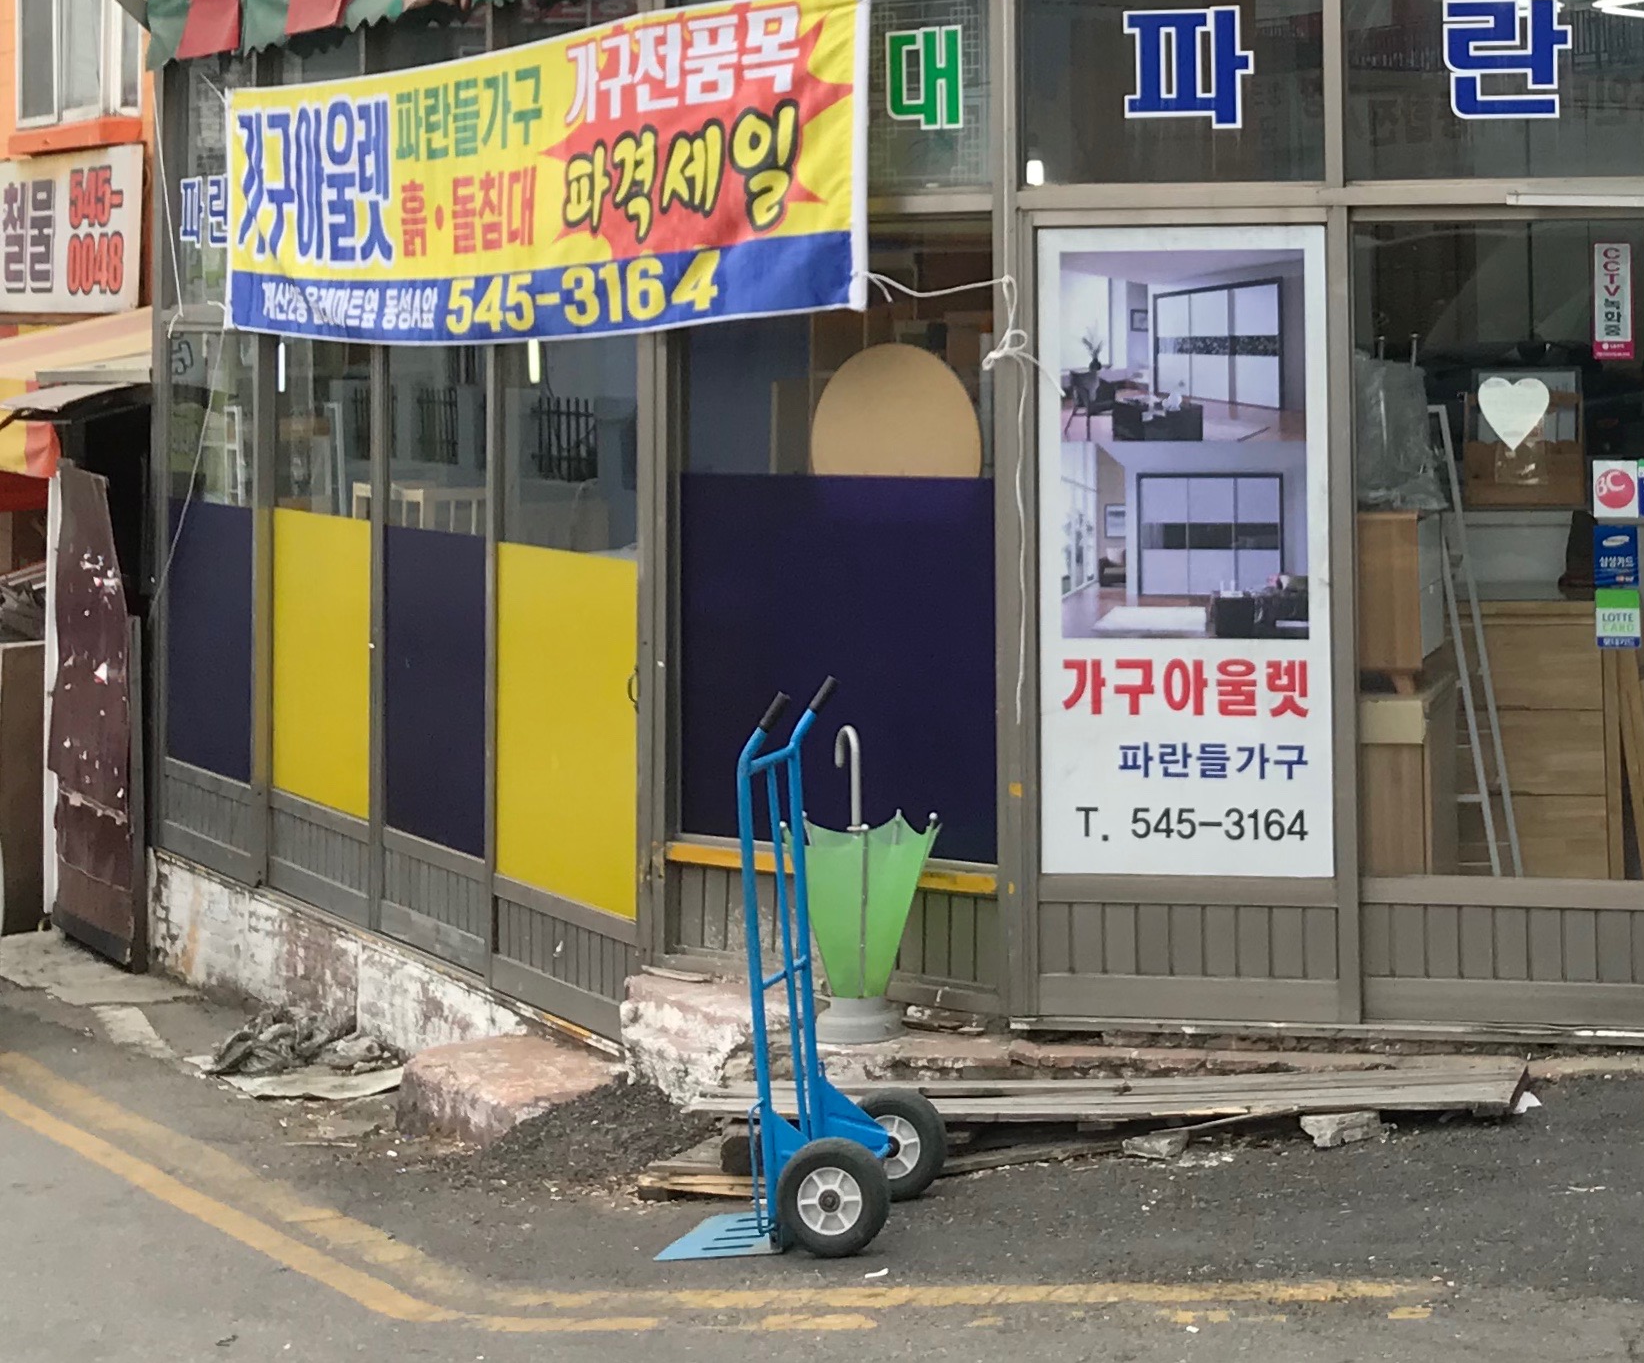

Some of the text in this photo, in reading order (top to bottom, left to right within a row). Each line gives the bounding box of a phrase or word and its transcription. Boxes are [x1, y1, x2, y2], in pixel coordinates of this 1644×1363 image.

[565, 2, 801, 125] 가구전품목
[886, 25, 964, 131] 대
[395, 65, 544, 162] 파란들가구
[236, 91, 395, 264] 가구아울렛
[563, 98, 801, 243] 파격세일
[66, 230, 125, 295] 0048
[445, 247, 720, 335] 545-3164
[1602, 613, 1635, 623] LOTTE
[1063, 659, 1309, 718] 가구아울렛
[1119, 742, 1308, 780] 파란들가구
[1076, 807, 1308, 842] T. 545-3164
